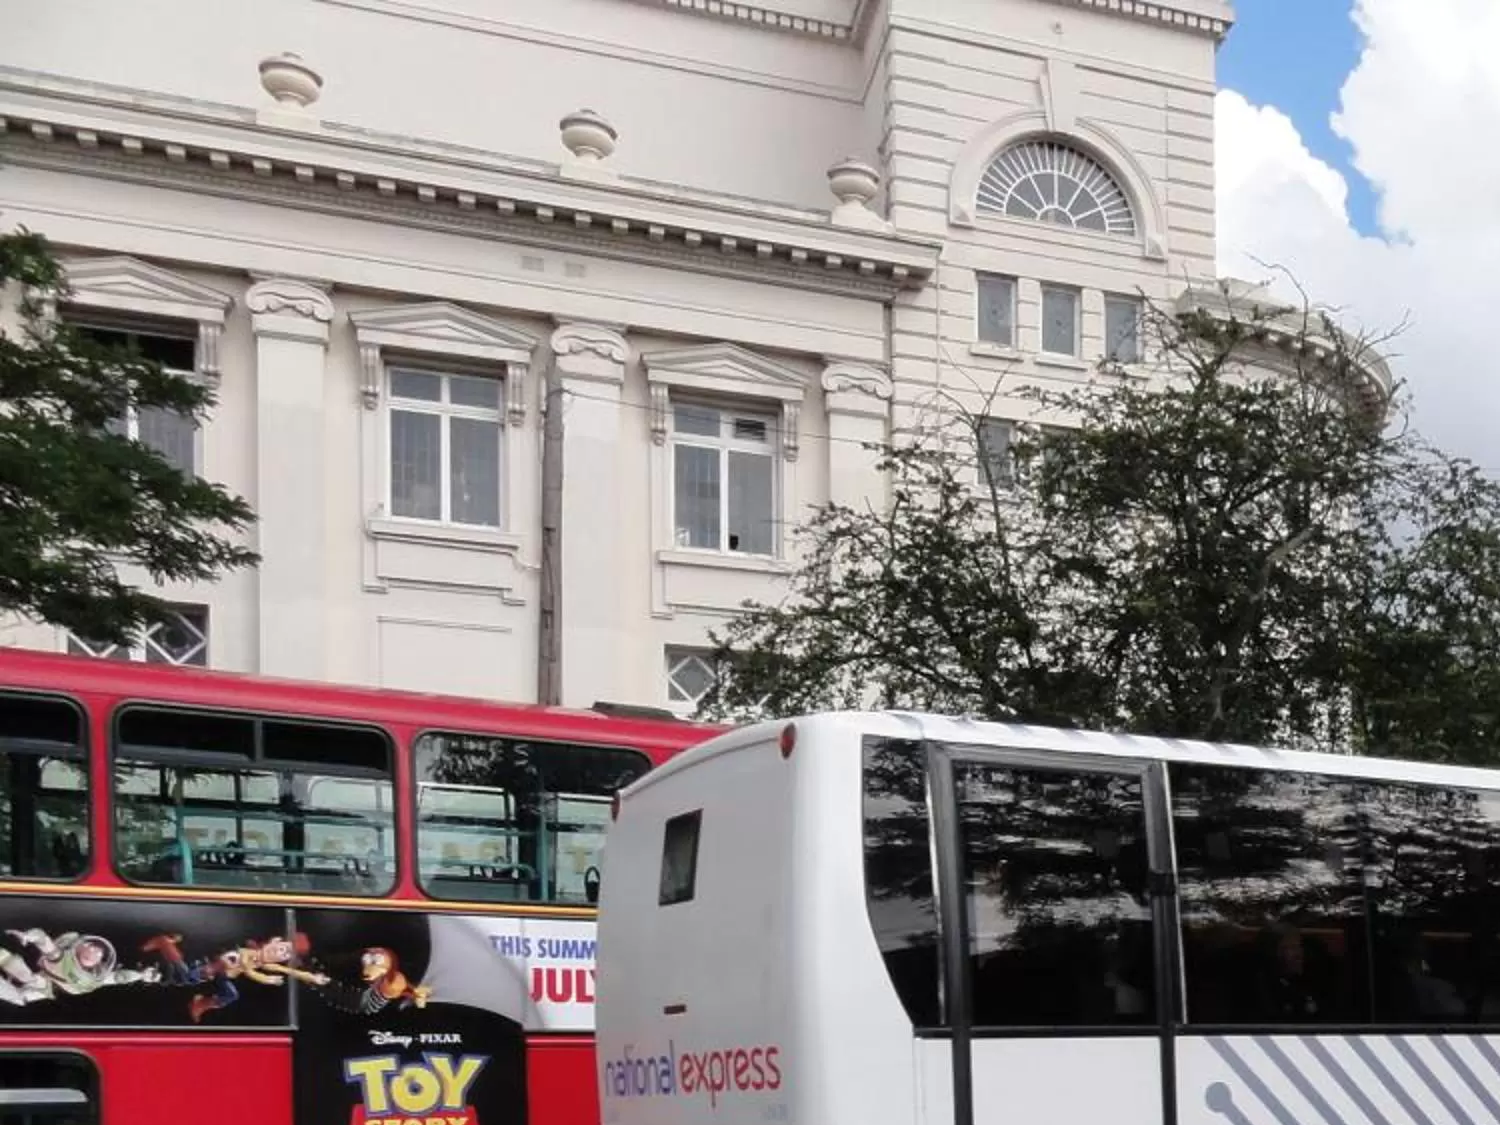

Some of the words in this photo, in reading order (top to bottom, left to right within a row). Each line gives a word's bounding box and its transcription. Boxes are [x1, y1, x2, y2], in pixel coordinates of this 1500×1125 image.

[489, 935, 532, 958] THIS
[368, 1030, 413, 1048] Disney
[419, 1033, 462, 1043] PIXAR
[345, 1052, 489, 1116] TOY
[605, 1039, 676, 1097] national
[679, 1046, 782, 1109] express
